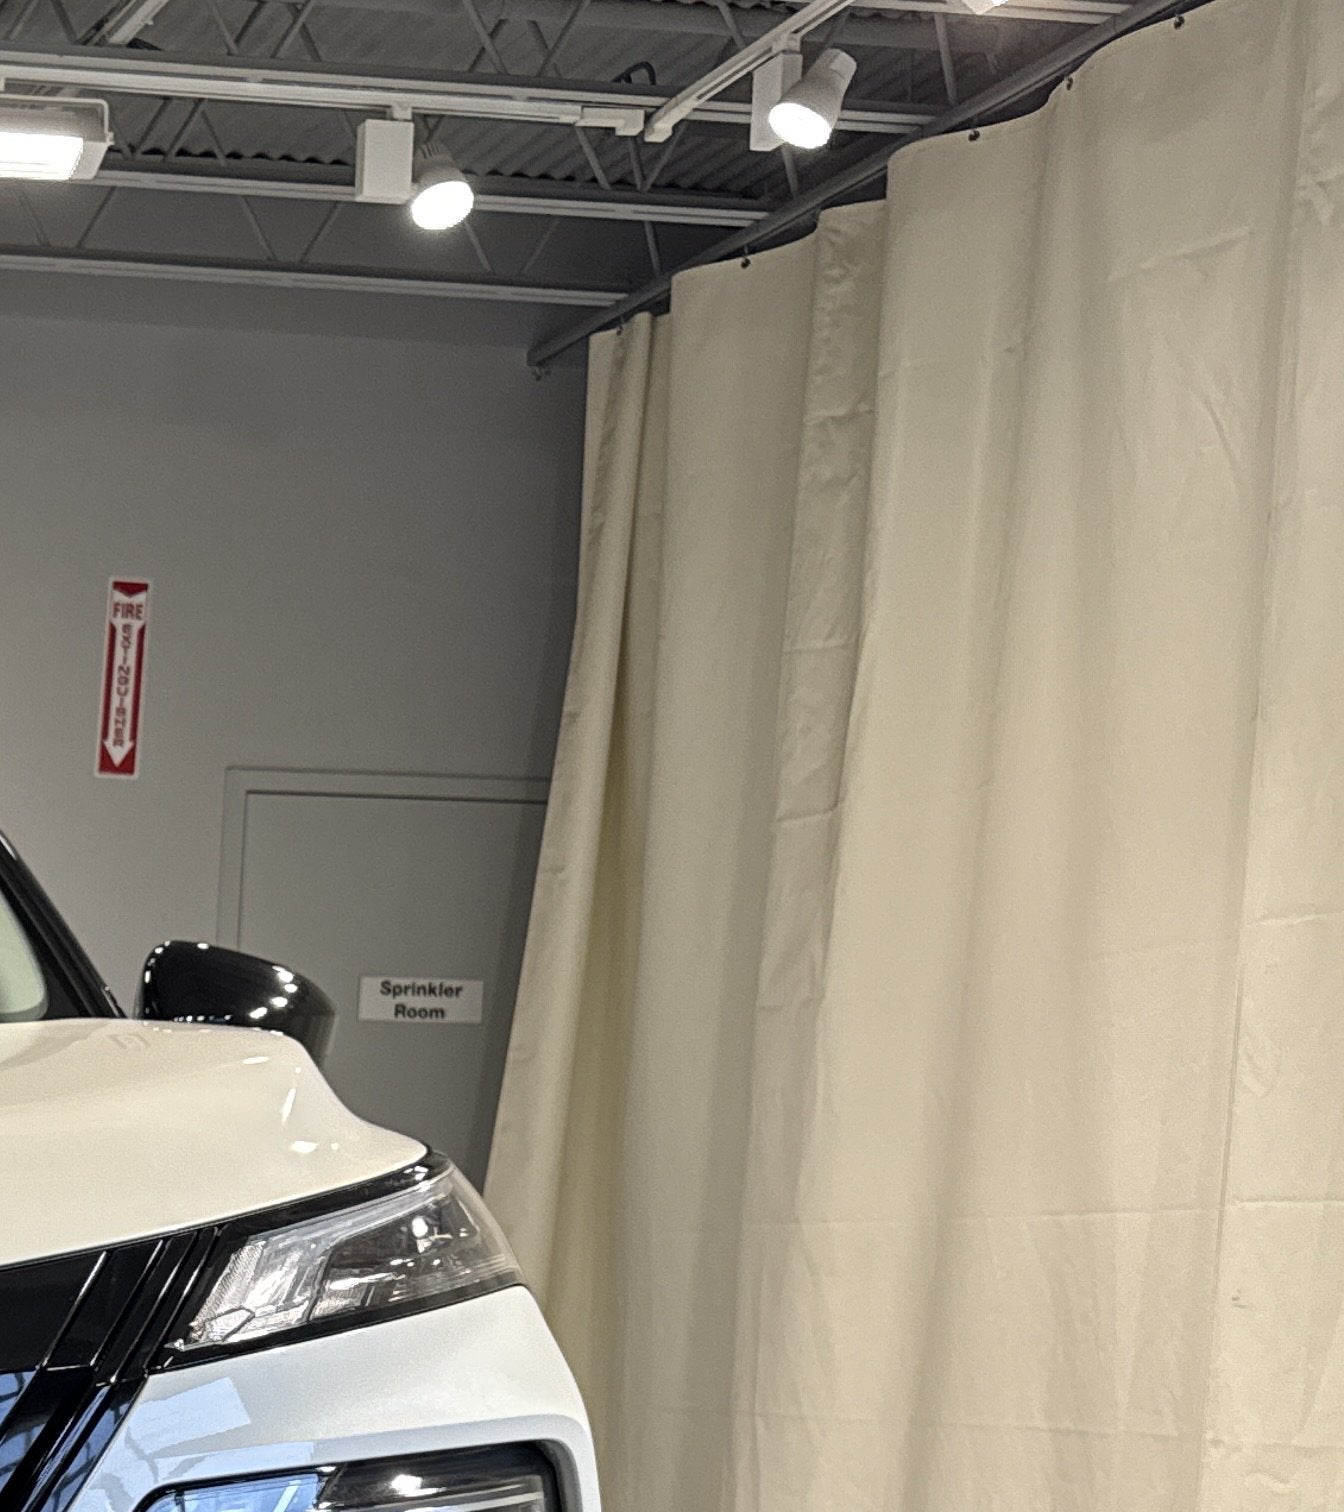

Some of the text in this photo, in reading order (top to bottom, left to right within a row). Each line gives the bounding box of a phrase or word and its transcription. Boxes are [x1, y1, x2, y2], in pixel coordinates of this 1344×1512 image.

[112, 602, 144, 620] FIRE
[112, 623, 133, 748] EXTINGUISHER
[379, 980, 463, 998] Sprinkler
[393, 1003, 446, 1020] Room
